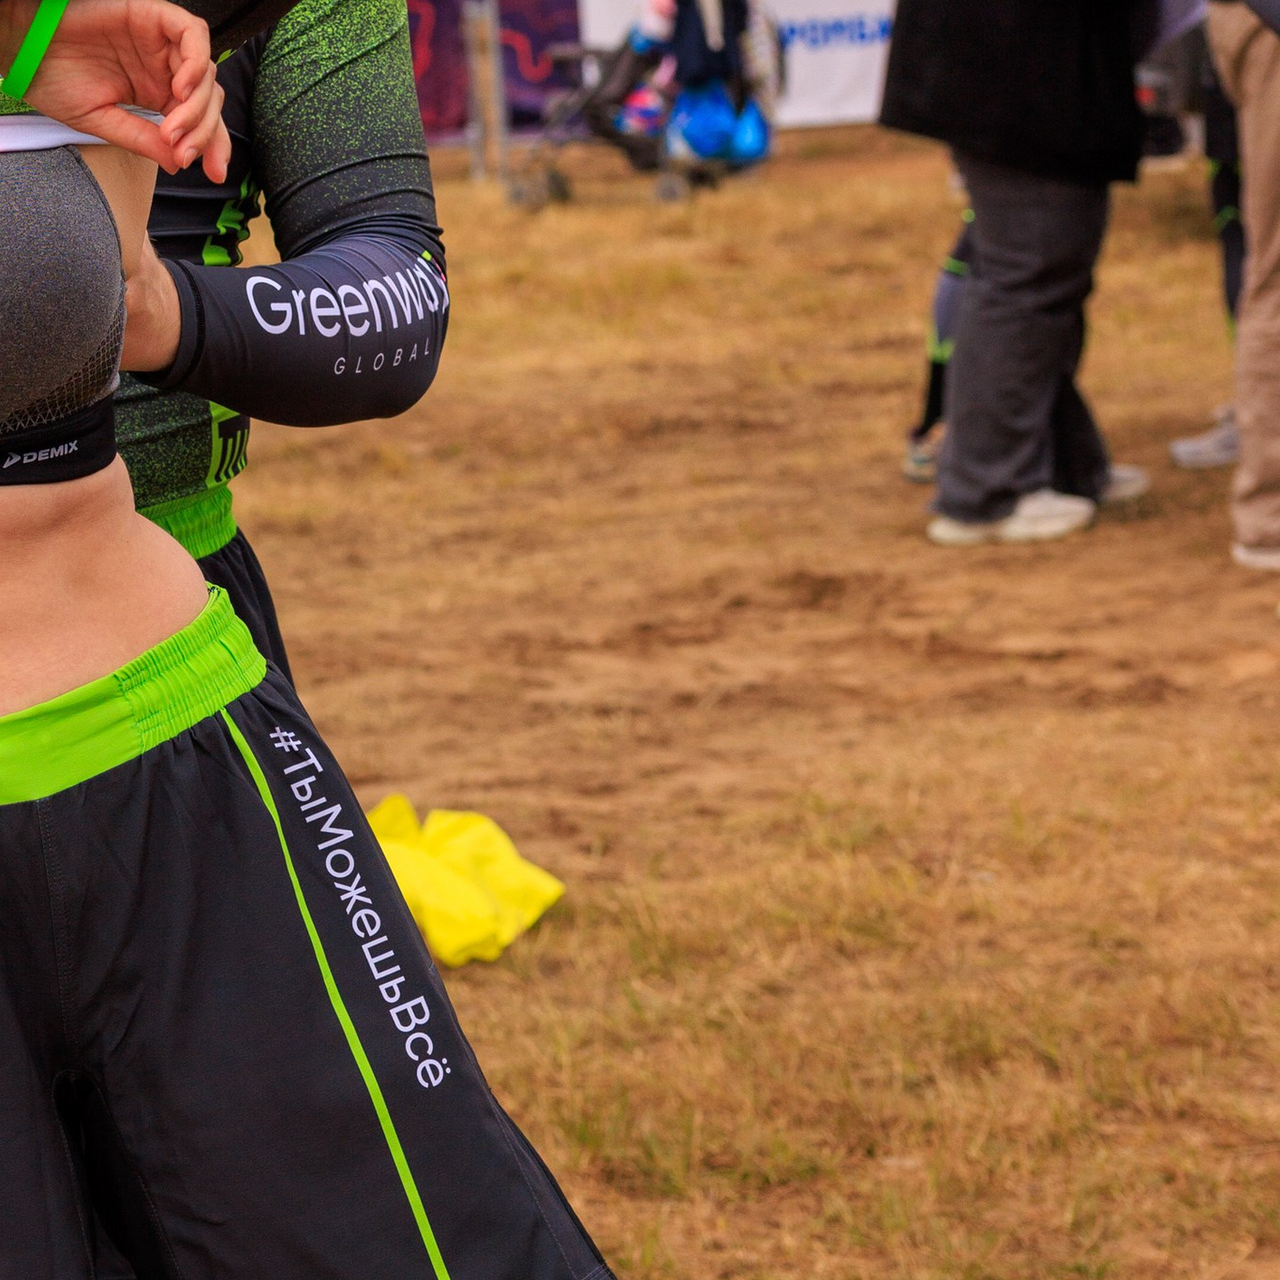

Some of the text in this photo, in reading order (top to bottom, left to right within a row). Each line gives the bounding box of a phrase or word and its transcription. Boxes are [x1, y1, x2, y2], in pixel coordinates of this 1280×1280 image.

[333, 337, 430, 376] GLOBAL
[22, 439, 79, 464] DEMIX
[268, 726, 452, 1089] #ТыМожешьВсё
